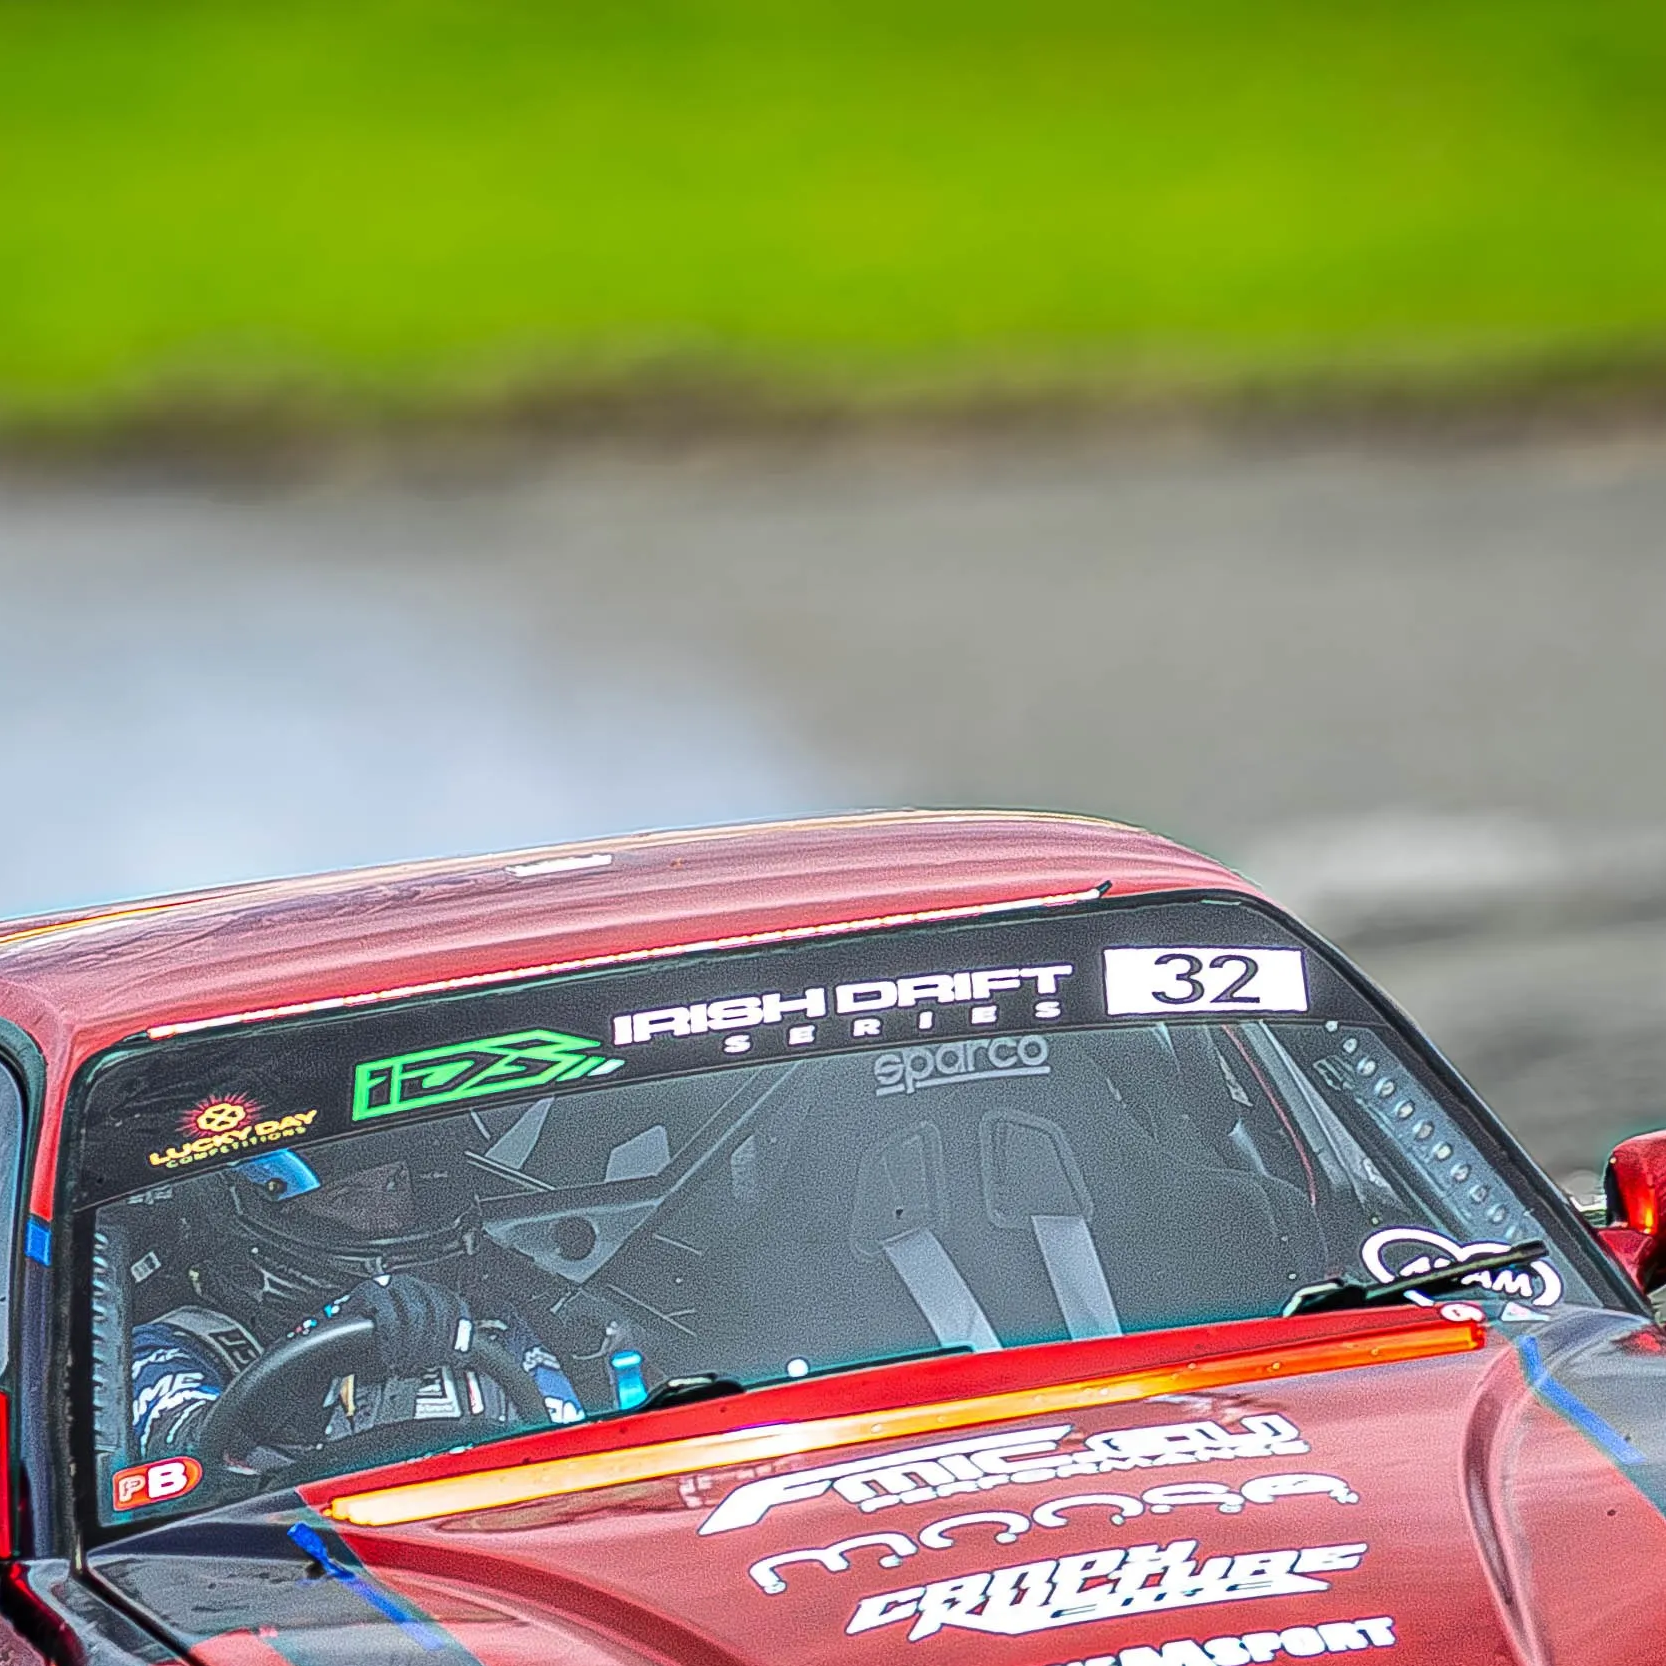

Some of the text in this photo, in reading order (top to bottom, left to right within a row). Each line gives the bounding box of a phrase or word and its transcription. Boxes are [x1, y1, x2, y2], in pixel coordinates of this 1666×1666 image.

[612, 965, 1074, 1045] IRISH DRIFT
[1152, 953, 1260, 1004] 32
[724, 1001, 1062, 1053] SERIES
[875, 1035, 1048, 1094] sparco
[148, 1109, 318, 1165] LUCKY DAY
[166, 1126, 307, 1169] COMPETITIONS
